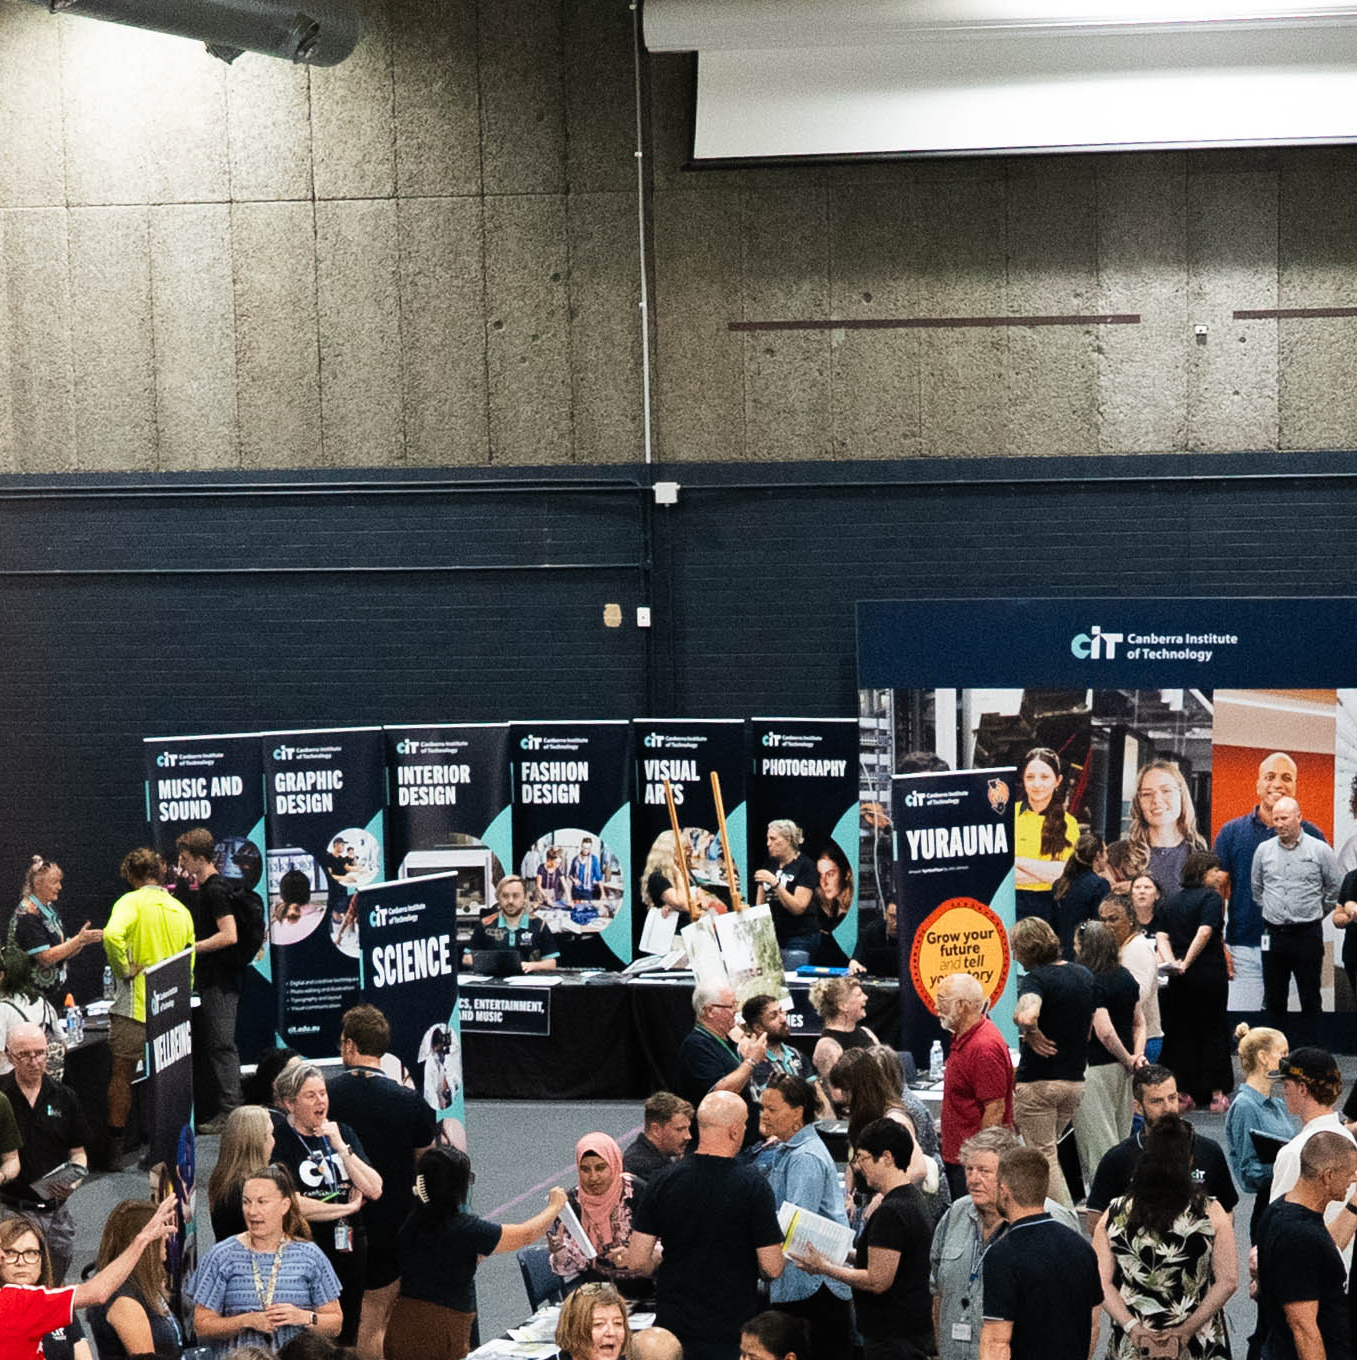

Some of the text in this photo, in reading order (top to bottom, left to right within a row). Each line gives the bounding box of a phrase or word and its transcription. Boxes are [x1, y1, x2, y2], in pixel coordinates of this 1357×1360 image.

[1127, 633, 1239, 644] Canberra Institute
[1127, 648, 1213, 662] of Technology
[397, 765, 471, 785] INTERIOR
[521, 761, 589, 782] FASHION
[644, 760, 700, 782] VISUAL
[762, 759, 846, 777] PHOTOGRAPHY
[158, 775, 243, 800] MUSIC AND
[275, 770, 343, 793] GRAPHIC
[276, 793, 333, 815] DESIGN
[398, 786, 456, 806] DESIGN
[522, 784, 580, 804] DESIGN
[159, 800, 212, 822] SOUND
[906, 823, 1009, 861] YURAUNA
[927, 929, 994, 945] Grow your
[940, 944, 980, 957] future
[372, 934, 452, 988] SCIENCE
[939, 954, 985, 971] and tell
[474, 998, 545, 1014] ENTERTAINMENT,
[475, 1011, 503, 1023] MUSIC
[153, 1020, 192, 1074] WELLBEING
